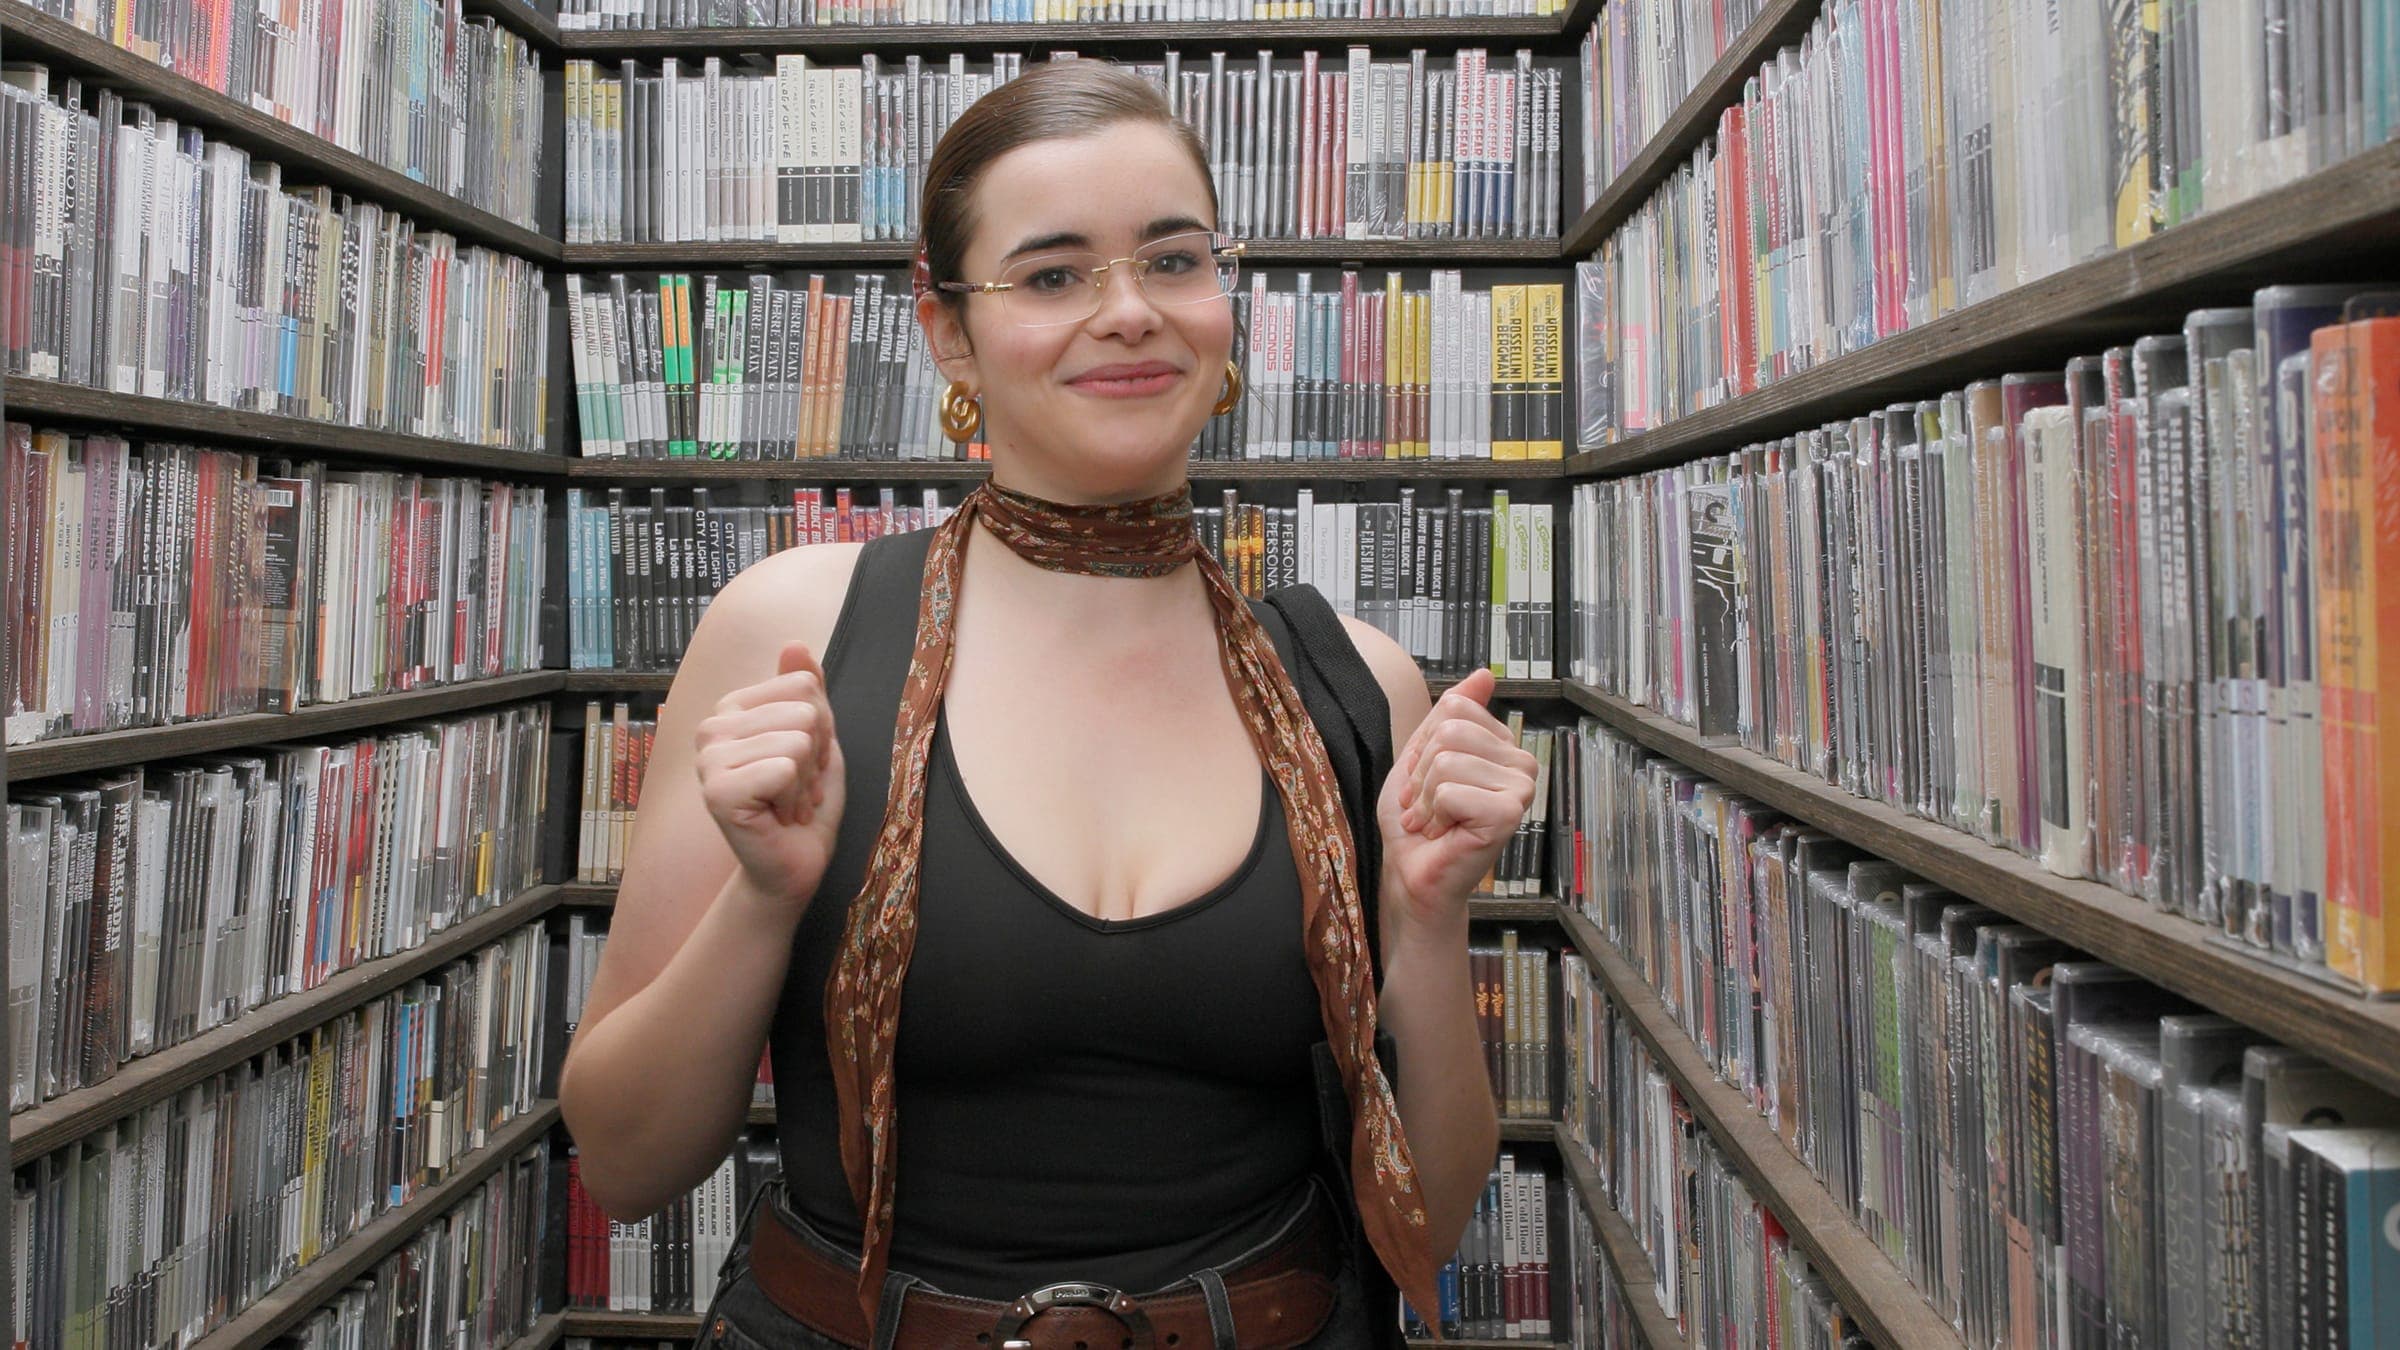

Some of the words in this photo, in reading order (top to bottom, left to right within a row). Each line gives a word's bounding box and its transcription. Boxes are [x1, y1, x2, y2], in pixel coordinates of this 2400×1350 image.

[1353, 58, 1364, 69] ON
[708, 72, 717, 100] Sunday
[780, 66, 790, 110] TRILOGY
[1353, 70, 1364, 86] THE
[1374, 73, 1385, 84] ON
[1393, 73, 1404, 84] ON
[1460, 57, 1470, 108] MINISTRY
[1474, 56, 1486, 107] MINISTRY
[38, 88, 46, 107] THE
[808, 78, 816, 117] TRILOGY
[838, 78, 846, 117] TRILOGY
[1393, 86, 1404, 100] THE
[1504, 79, 1513, 120] MINISTRY
[708, 102, 717, 128] Bloody
[780, 116, 790, 129] OF
[808, 121, 816, 133] OF
[838, 120, 846, 132] OF
[1352, 88, 1364, 139] WATERFRONT
[1460, 112, 1470, 125] OF
[1474, 112, 1485, 125] OF
[1519, 106, 1529, 147] ESCAPED
[1373, 102, 1385, 154] WATERFRONT
[1393, 102, 1404, 154] WATERFRONT
[1460, 128, 1470, 156] FEAR
[1474, 128, 1485, 155] FEAR
[1504, 124, 1513, 134] OF
[1532, 113, 1543, 152] ESCAPED
[1547, 113, 1558, 152] ESCAPED
[36, 114, 45, 182] HONEYMOON
[66, 98, 79, 192] UMBERTO
[708, 131, 717, 158] Sunday
[780, 134, 790, 158] LIFE
[808, 136, 816, 156] LIFE
[838, 136, 846, 156] LIFE
[1504, 138, 1513, 159] FEAR
[64, 195, 77, 212] D.
[706, 283, 716, 306] REPO
[751, 286, 764, 330] PIERRE
[789, 293, 803, 336] PIERRE
[852, 313, 864, 343] YUMA
[866, 313, 878, 342] YUMA
[1253, 288, 1264, 352] SECONDS
[880, 332, 892, 362] YUMA
[895, 333, 907, 362] YUMA
[1267, 306, 1277, 370] SECONDS
[1283, 306, 1293, 370] SECONDS
[1497, 326, 1508, 378] BERGMAN
[1510, 318, 1522, 378] ROSSELLINI
[1532, 325, 1544, 378] BERGMAN
[1546, 318, 1558, 378] ROSSELLINI
[2157, 428, 2170, 506] HIGH
[2170, 418, 2183, 496] HIGH
[146, 459, 155, 508] YOUTH
[177, 460, 186, 524] FIGHTING
[610, 502, 620, 516] THE
[796, 500, 808, 529] TOUKI
[810, 500, 821, 529] TOUKI
[1402, 498, 1412, 516] RIOT
[610, 518, 620, 554] UNINVITED
[638, 522, 649, 536] THE
[654, 522, 664, 535] La
[696, 510, 706, 536] CITY
[709, 521, 719, 547] CITY
[725, 522, 734, 548] CITY
[1402, 518, 1412, 526] IN
[1402, 528, 1411, 544] CELL
[1417, 516, 1427, 534] RIOT
[1434, 520, 1444, 538] RIOT
[142, 524, 151, 572] BEAST
[175, 528, 183, 571] ELEGY
[655, 537, 665, 564] Notte
[670, 538, 680, 550] La
[684, 538, 694, 550] La
[1416, 546, 1426, 562] CELL
[1417, 536, 1426, 544] IN
[1433, 540, 1443, 548] IN
[639, 538, 650, 576] UNINVITED
[670, 552, 680, 579] Notte
[684, 552, 694, 578] Notte
[697, 540, 707, 578] LIGHTS
[1268, 522, 1278, 588] PERSONA
[1283, 524, 1294, 588] PERSONA
[1360, 530, 1374, 586] FRESHMAN
[1382, 534, 1396, 589] FRESHMAN
[1401, 545, 1411, 568] BLOCK
[1433, 550, 1442, 566] CELL
[710, 551, 720, 588] LIGHTS
[1416, 564, 1426, 586] BLOCK
[1432, 567, 1442, 590] BLOCK
[629, 737, 640, 762] RED
[586, 779, 594, 794] Love
[627, 766, 640, 805] RIVER
[108, 836, 118, 911] CONFIDENTIAL
[111, 848, 126, 951] ARKADIN
[105, 914, 113, 952] REPORT
[1476, 992, 1489, 1016] Rose
[1492, 993, 1504, 1016] Rose
[2038, 1029, 2049, 1088] LOST
[2040, 1097, 2052, 1204] HIGHWAY
[724, 1174, 732, 1204] MASTER
[1503, 1170, 1512, 1182] In
[1504, 1185, 1513, 1208] Cold
[1518, 1186, 1528, 1196] In
[1534, 1186, 1543, 1197] In
[724, 1206, 732, 1236] BUILDER
[1504, 1211, 1514, 1240] Blood
[1519, 1200, 1529, 1224] Cold
[1534, 1200, 1544, 1224] Cold
[1520, 1226, 1530, 1255] Blood
[1535, 1226, 1545, 1256] Blood
